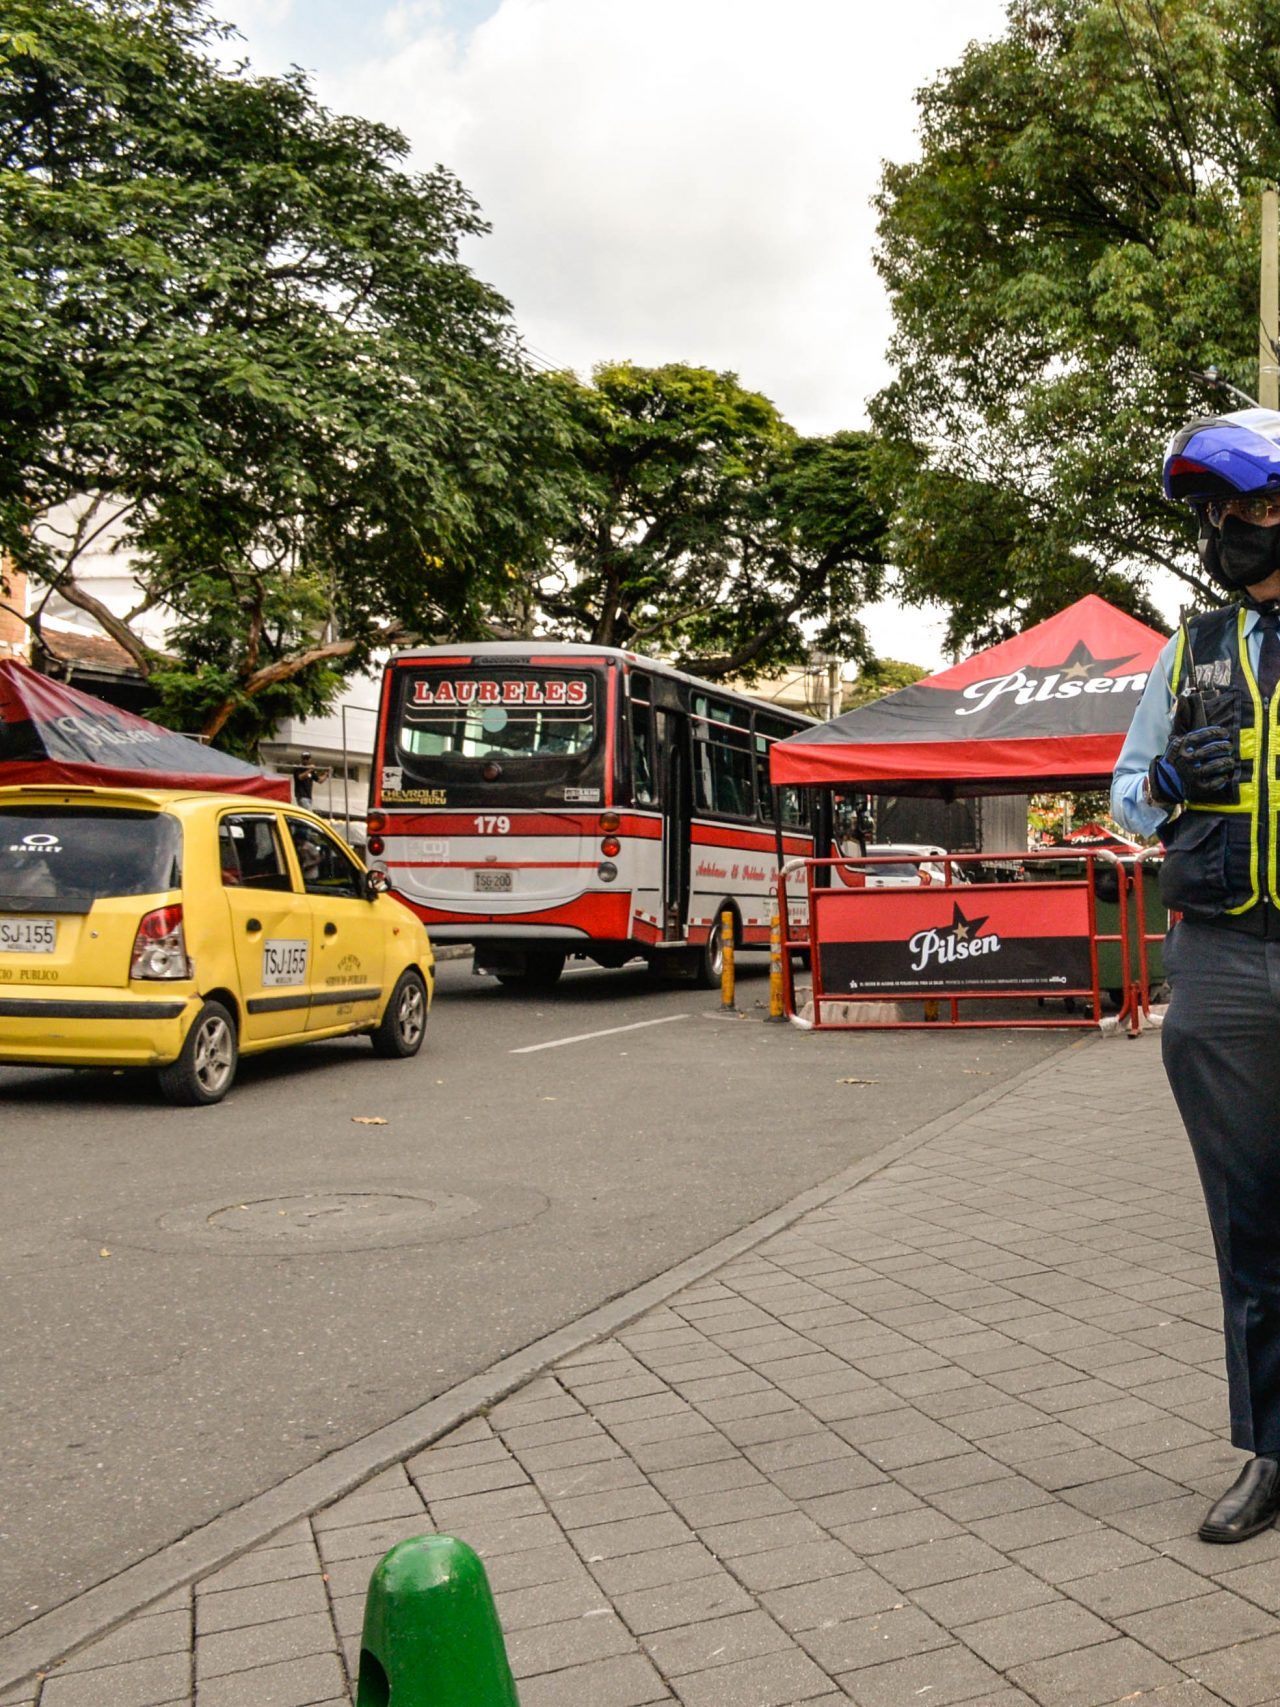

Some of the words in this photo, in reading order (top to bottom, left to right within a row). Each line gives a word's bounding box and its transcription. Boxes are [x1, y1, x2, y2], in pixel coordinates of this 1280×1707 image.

[413, 681, 587, 704] LAURELES
[955, 667, 1148, 715] Pilsen
[58, 716, 160, 746] Pilsen
[381, 789, 446, 798] CHEVROLET
[474, 816, 510, 834] 179
[9, 844, 63, 853] OAKLEY
[0, 924, 53, 944] SJ-155
[909, 929, 1001, 971] Pilsen
